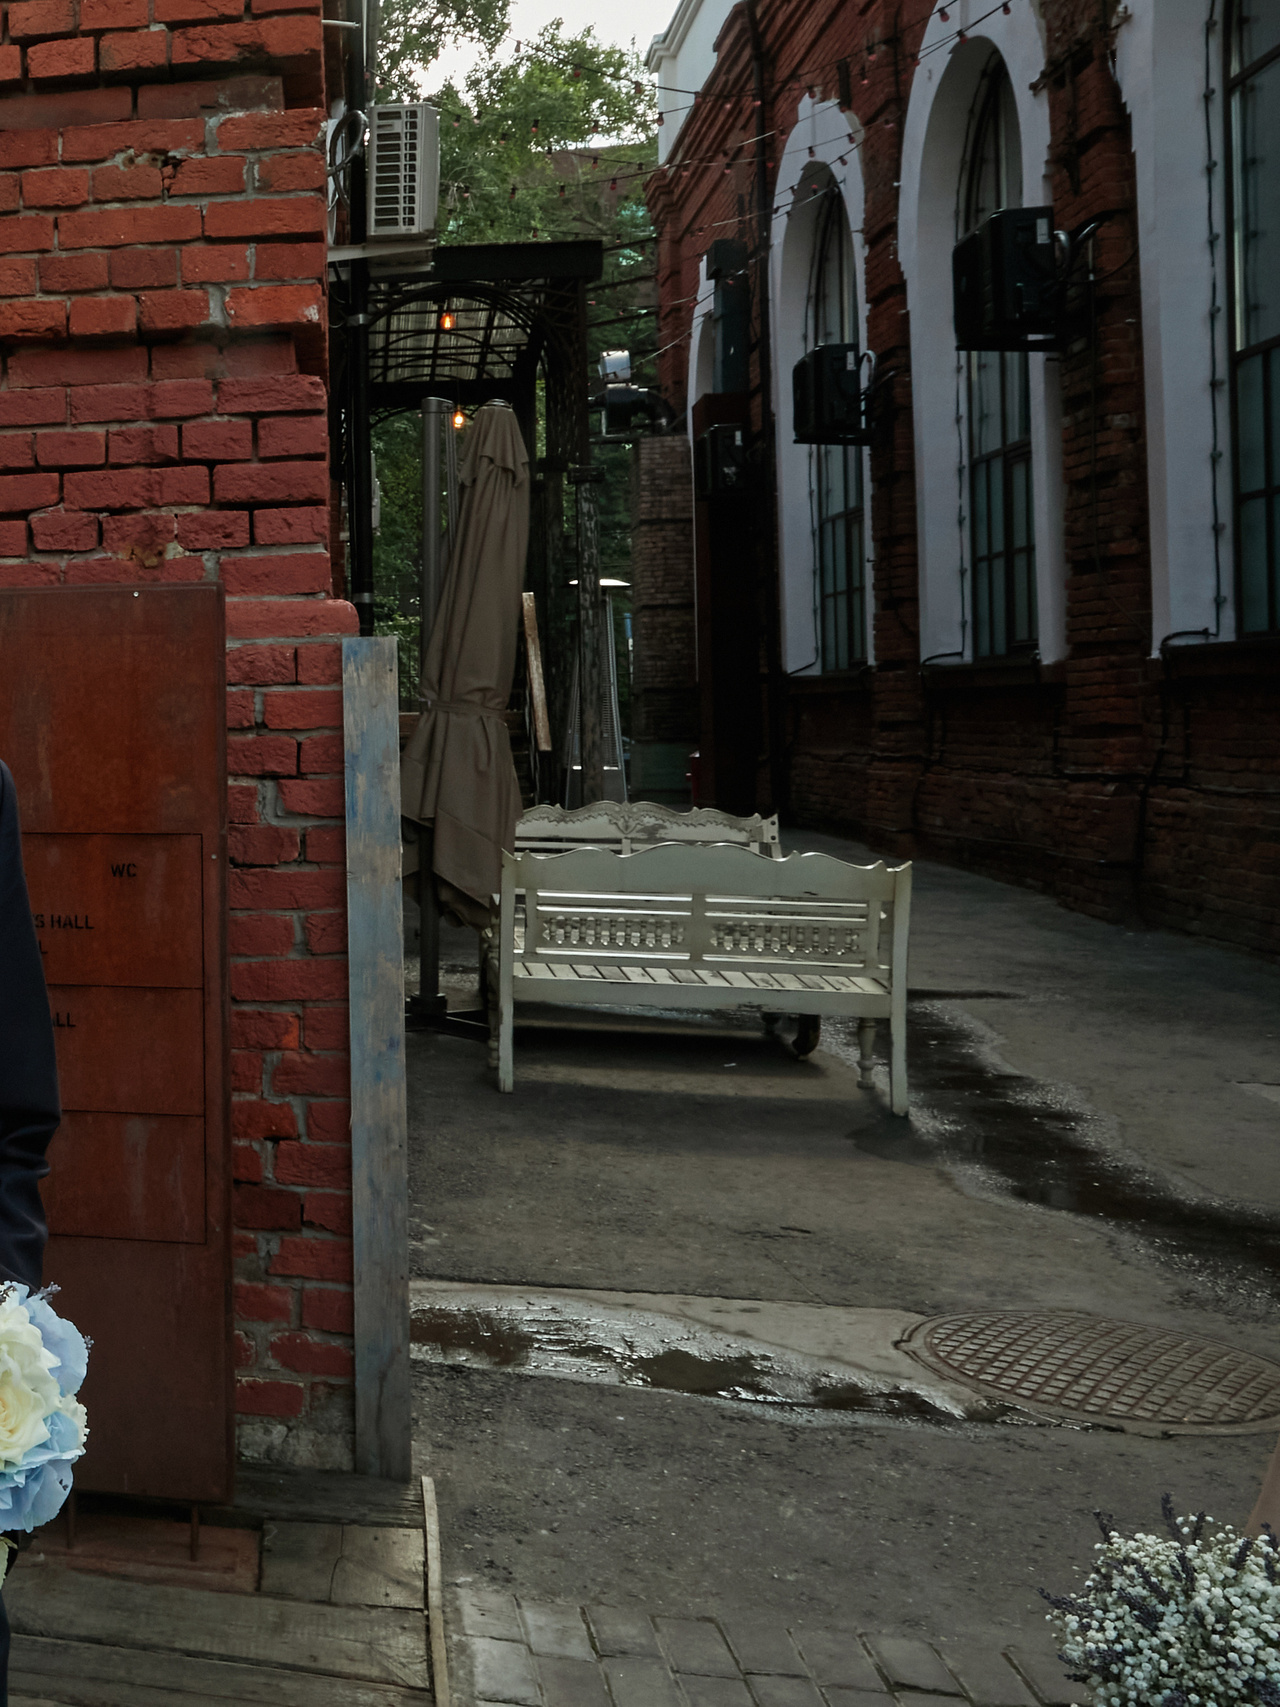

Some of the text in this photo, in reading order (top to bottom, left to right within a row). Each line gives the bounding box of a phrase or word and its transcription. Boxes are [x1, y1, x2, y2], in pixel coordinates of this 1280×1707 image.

[111, 863, 137, 878] WC
[50, 914, 95, 930] HALL
[52, 1012, 77, 1028] LL
